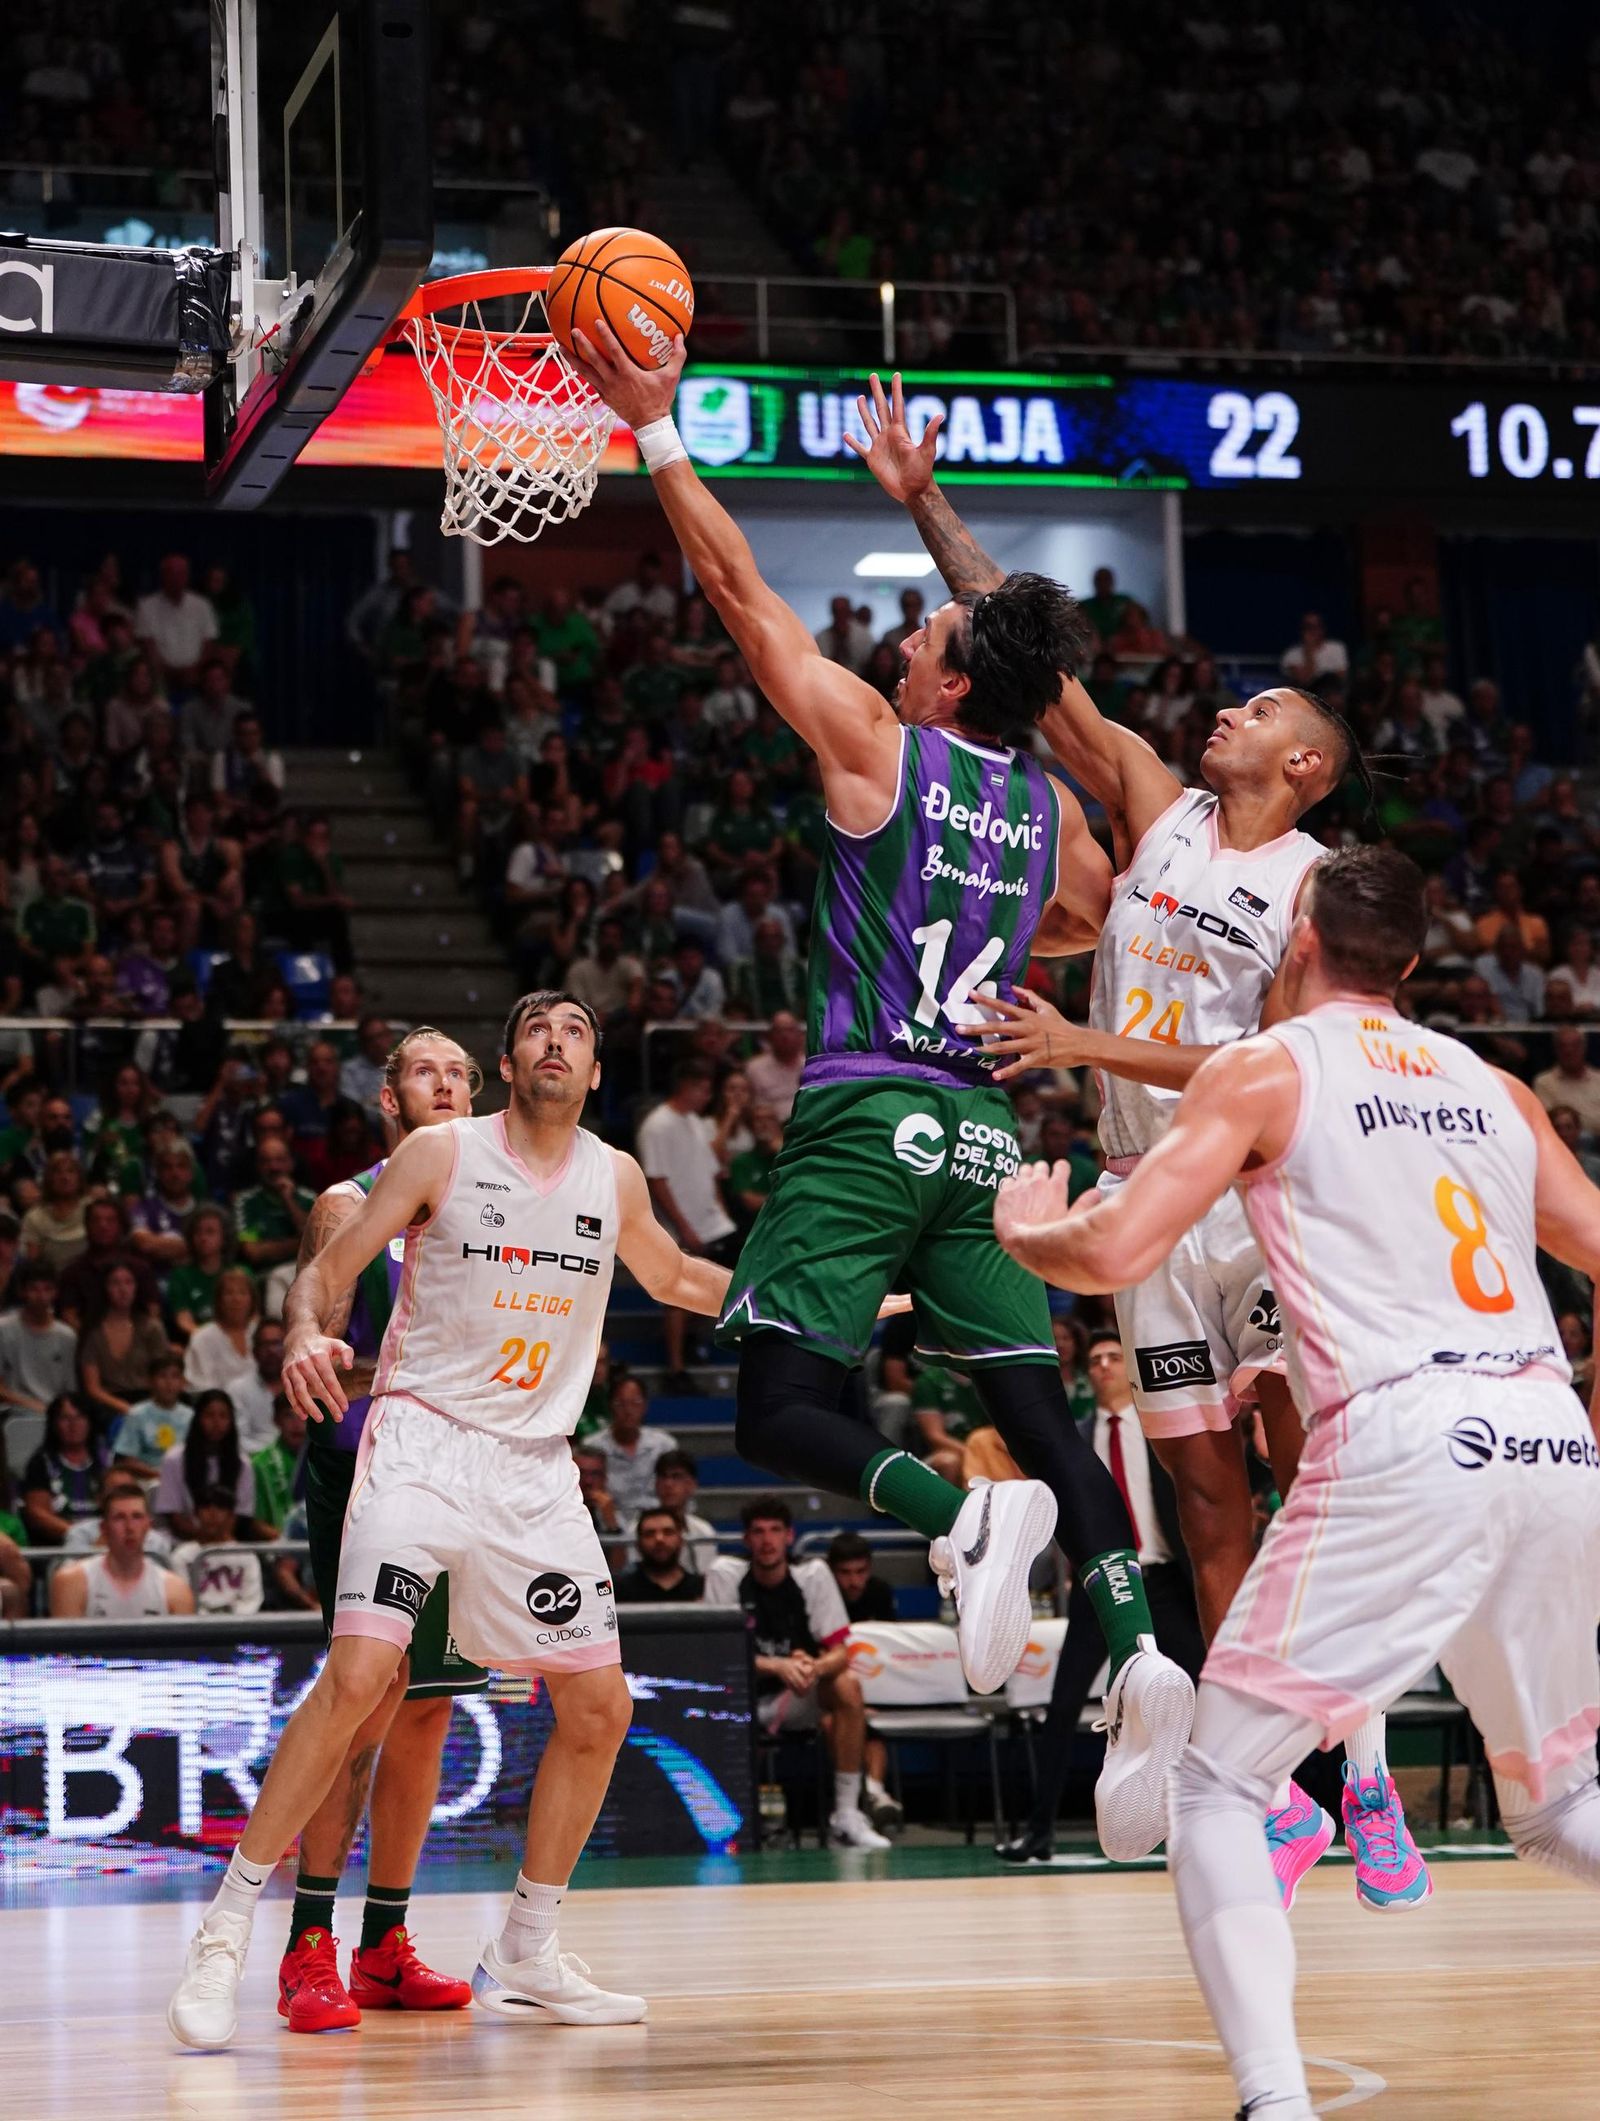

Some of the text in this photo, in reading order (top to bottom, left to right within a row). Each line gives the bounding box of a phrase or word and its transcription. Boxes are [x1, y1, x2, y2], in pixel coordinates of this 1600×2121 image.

[799, 391, 1064, 464] UNCAJA
[1208, 391, 1301, 479] 22
[921, 781, 1044, 851] Đedović
[1128, 935, 1211, 978] LLEIDA
[912, 918, 1006, 1048] 14
[1119, 987, 1186, 1047] 24
[954, 1142, 1018, 1179] DEL SOL
[959, 1120, 1022, 1161] COSTA
[1434, 1175, 1515, 1314] 8
[492, 1289, 575, 1317] LLEIDA
[491, 1337, 553, 1391] 29
[1150, 1354, 1205, 1379] PONS
[390, 1576, 425, 1609] PON
[528, 1583, 579, 1613] Q2
[536, 1625, 592, 1645] CUDÓS
